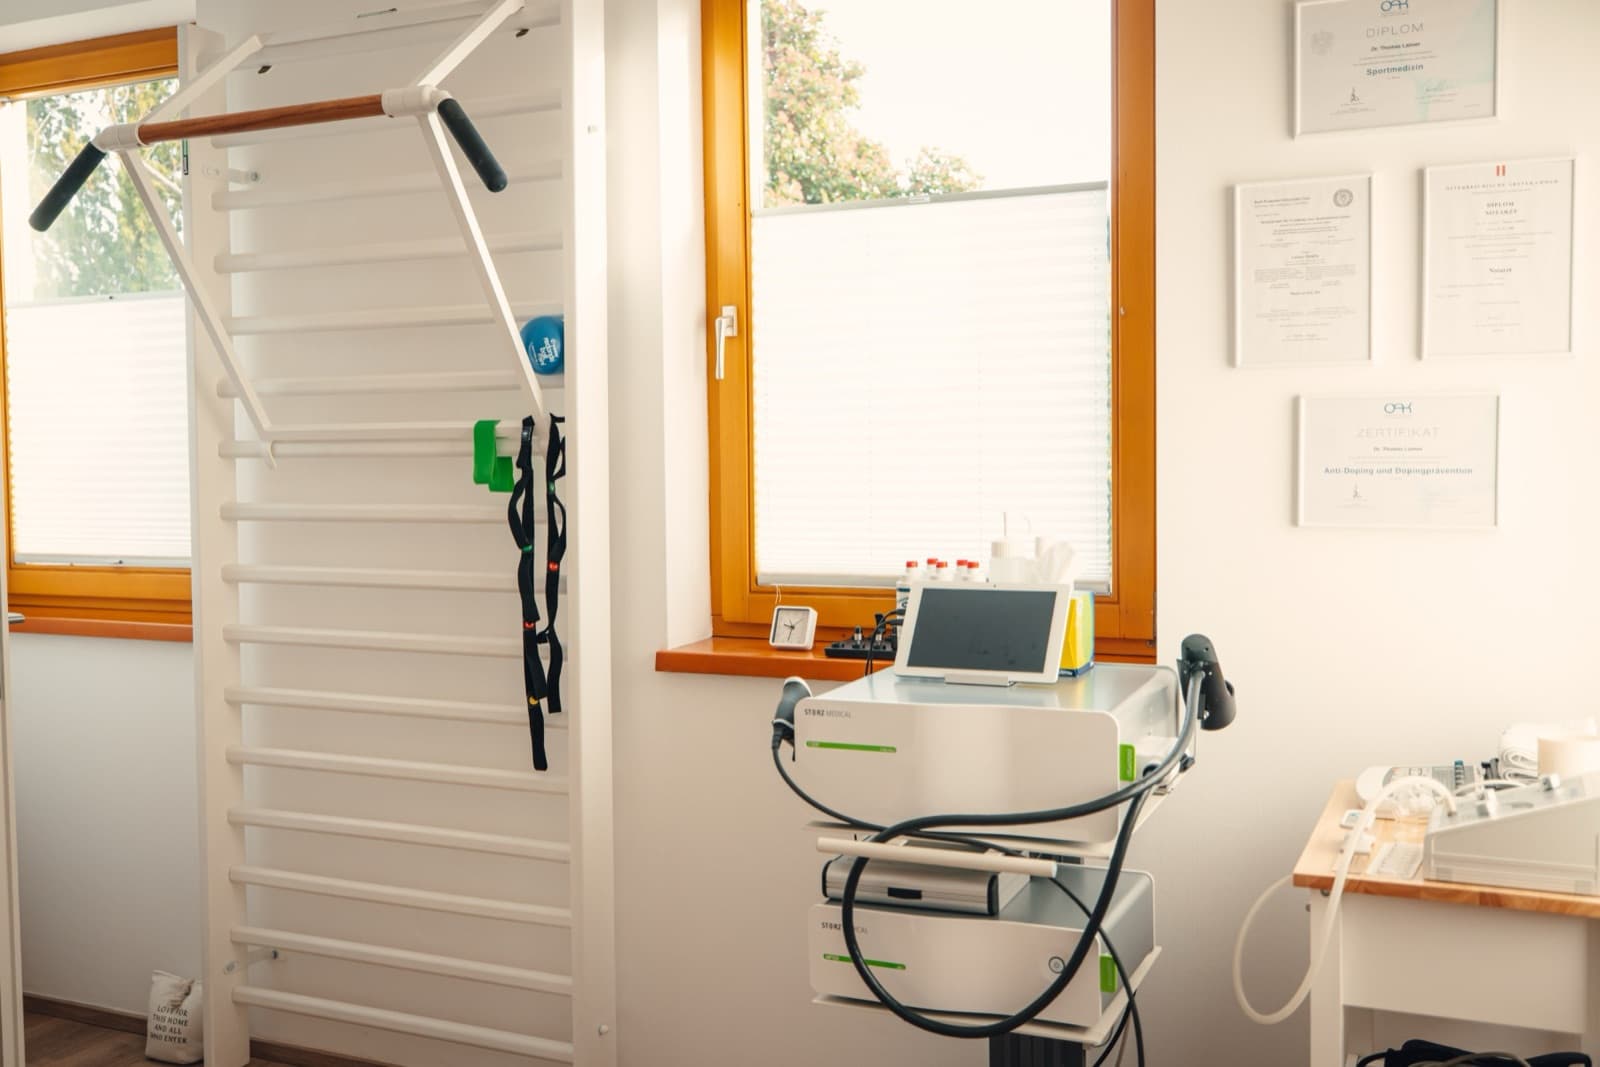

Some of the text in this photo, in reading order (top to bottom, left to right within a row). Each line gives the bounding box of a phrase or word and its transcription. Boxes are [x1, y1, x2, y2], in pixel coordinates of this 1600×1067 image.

[1366, 23, 1424, 38] DIPLOM
[1366, 63, 1424, 76] Sportmedizin
[1356, 427, 1440, 438] ZERTIFIKAT
[804, 708, 825, 717] STORZ
[821, 922, 841, 930] STORZ
[153, 1014, 188, 1026] THIS HOME
[155, 1024, 182, 1035] AND ALL
[164, 1034, 188, 1044] ENTER
